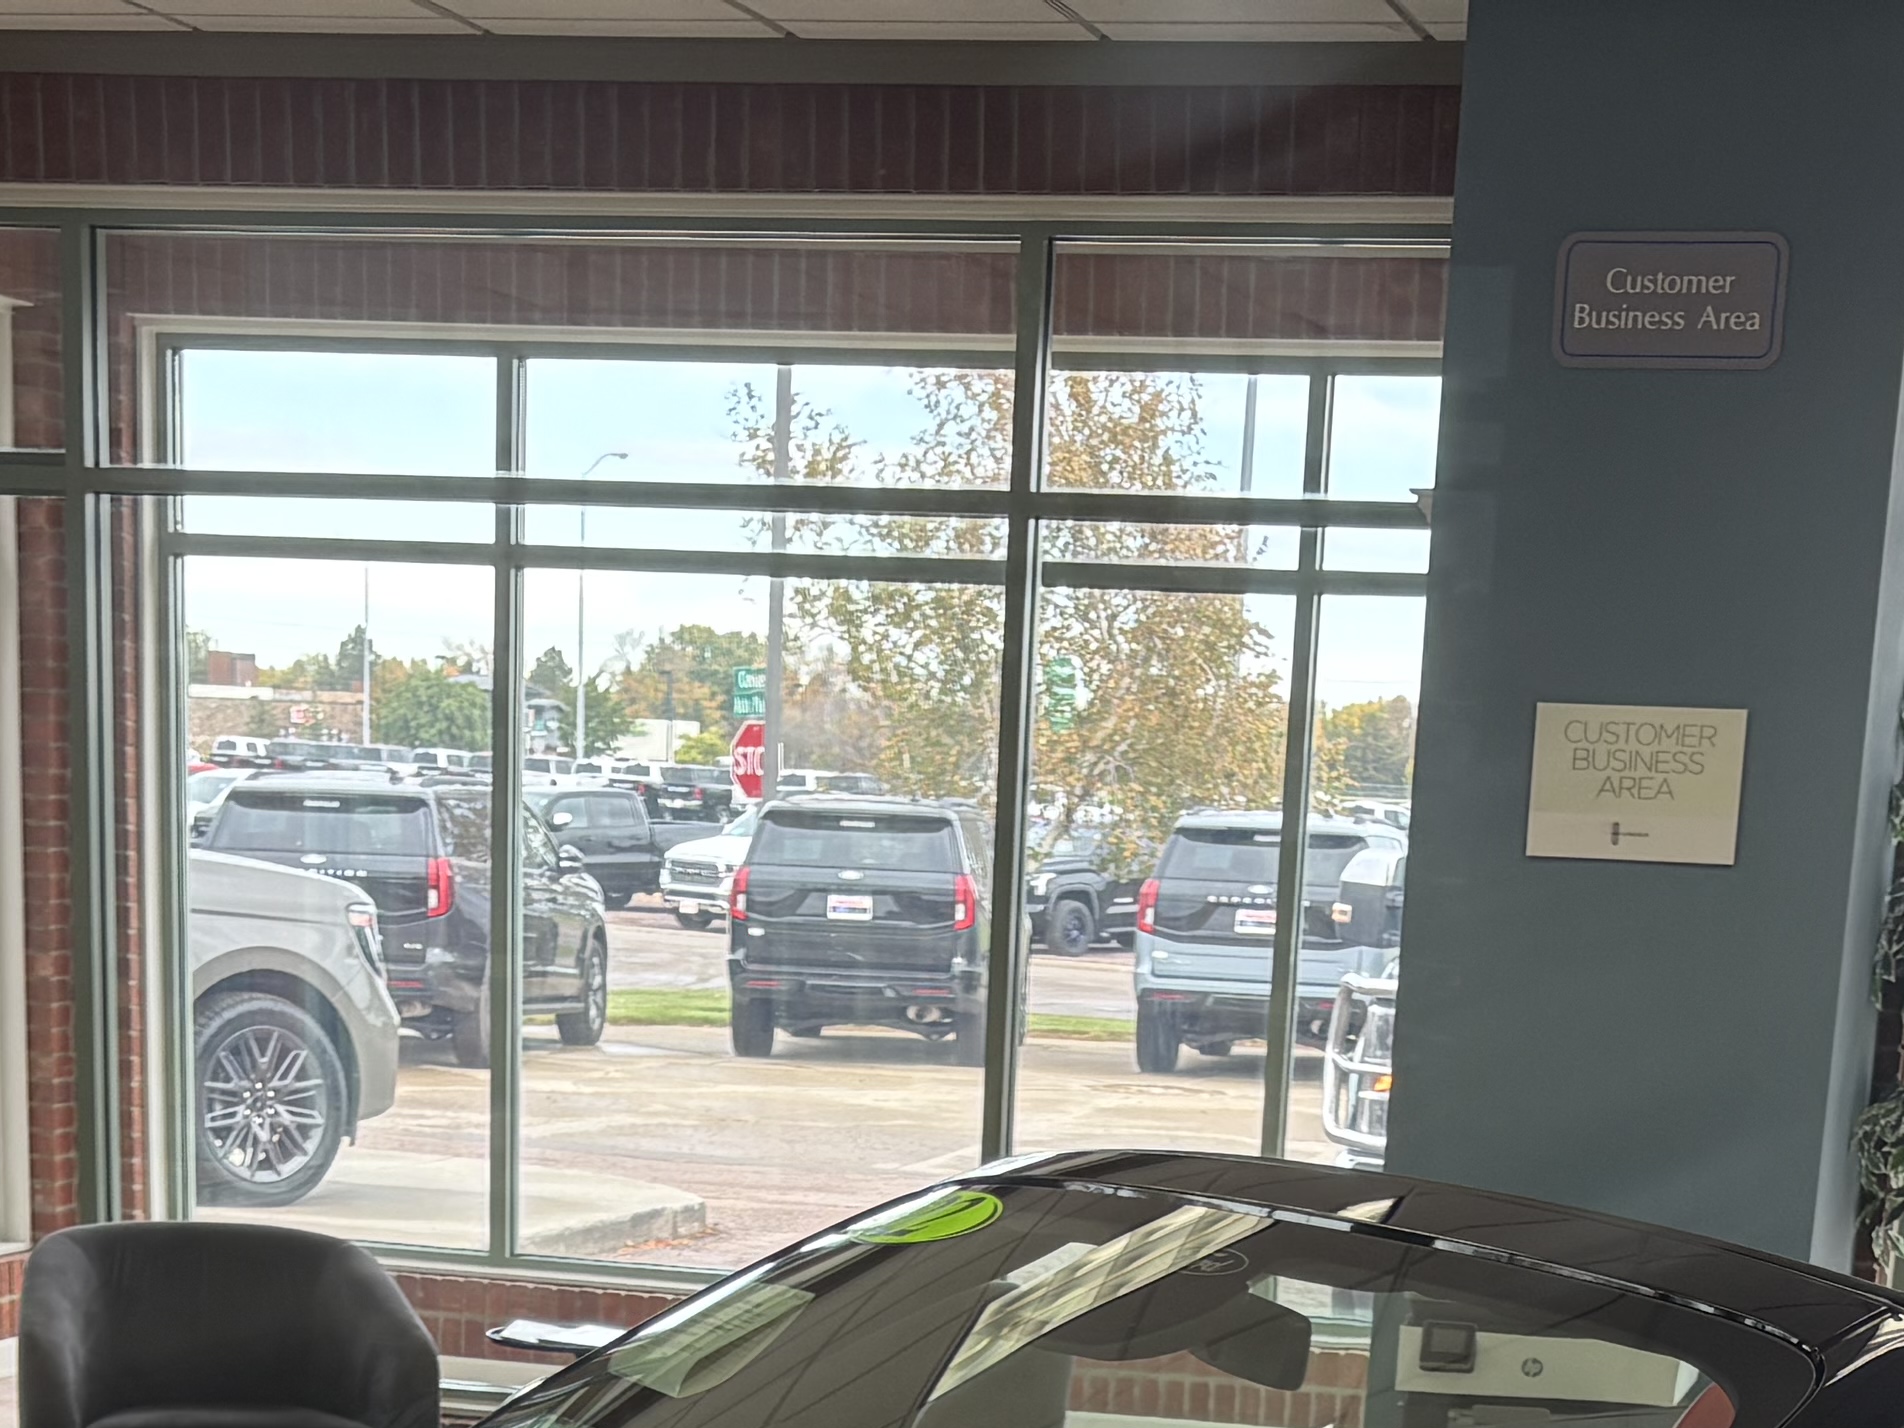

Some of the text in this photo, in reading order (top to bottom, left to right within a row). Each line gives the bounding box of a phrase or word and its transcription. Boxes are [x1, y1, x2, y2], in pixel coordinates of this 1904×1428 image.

[1606, 267, 1736, 294] Customer
[1573, 302, 1761, 331] Business Area
[1564, 719, 1718, 748] CUSTOMER
[1572, 747, 1705, 776] BUSINESS
[1596, 775, 1675, 801] AREA
